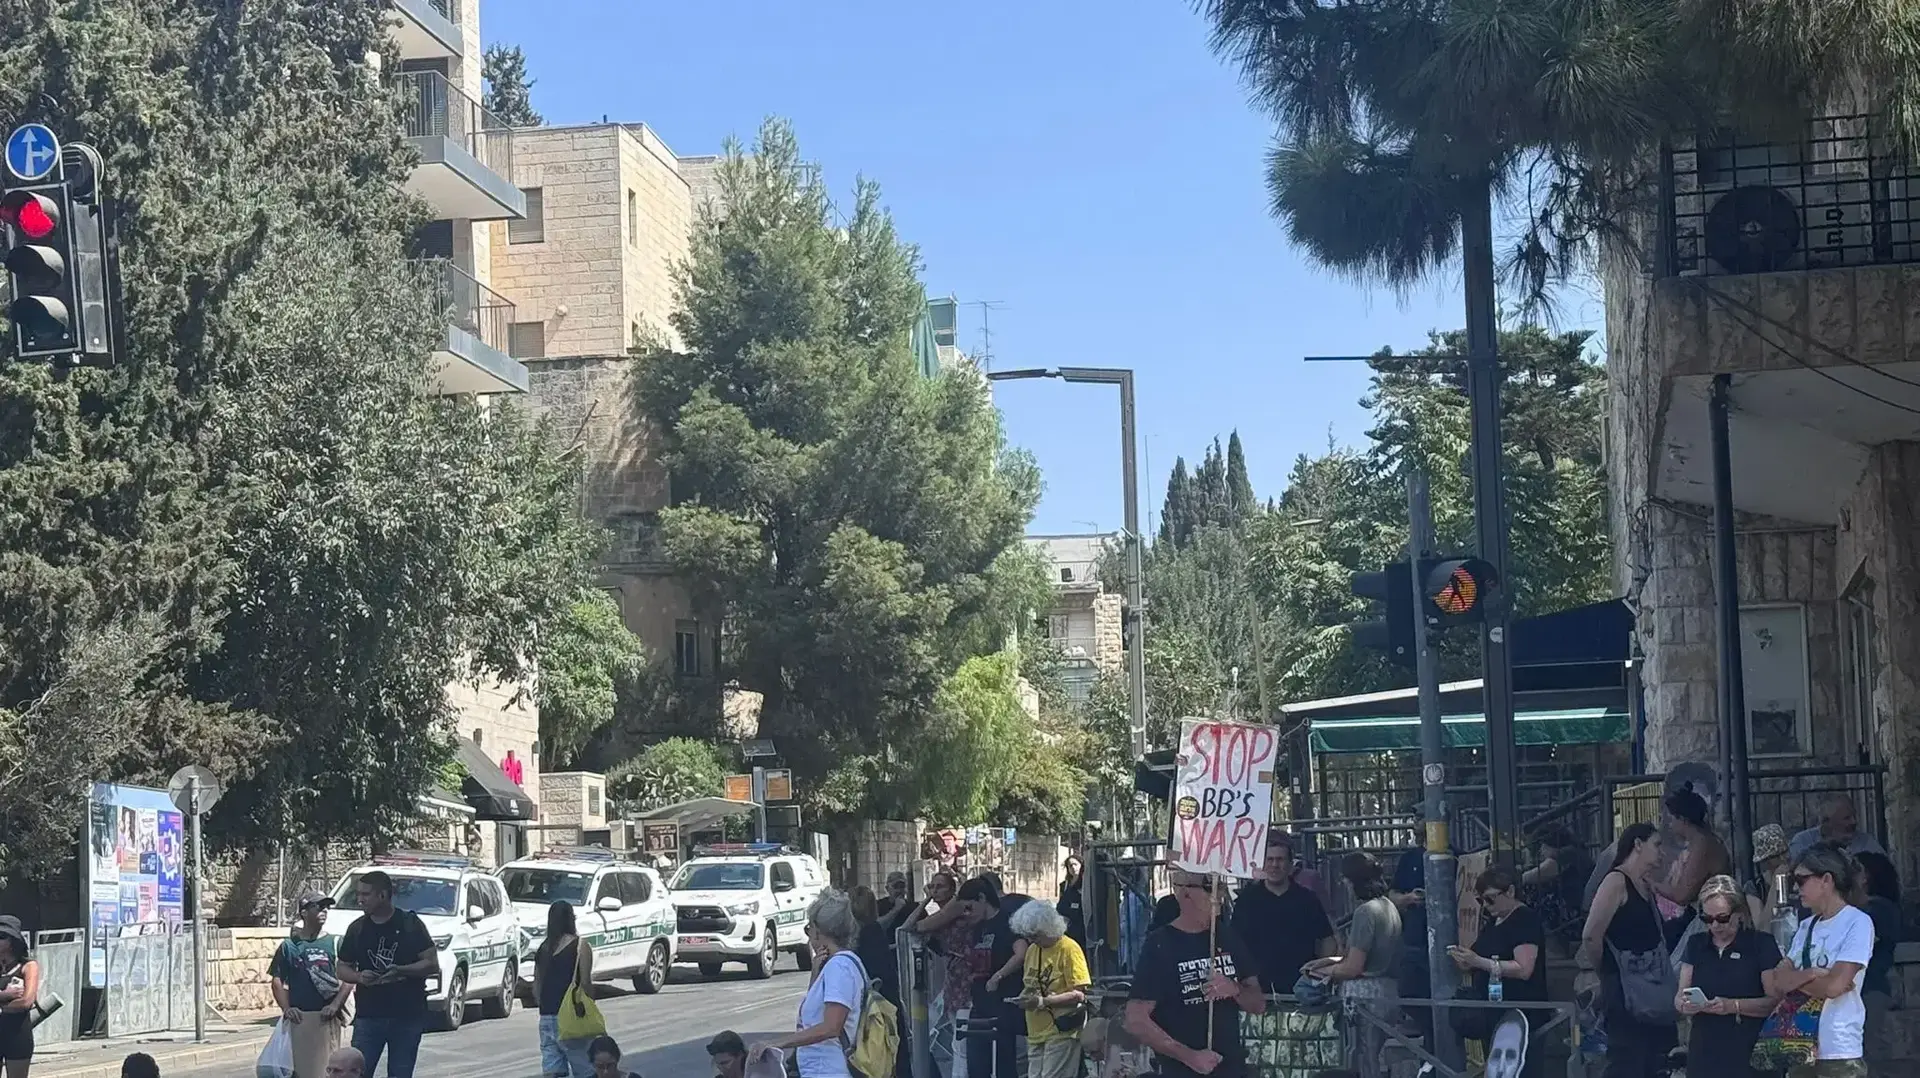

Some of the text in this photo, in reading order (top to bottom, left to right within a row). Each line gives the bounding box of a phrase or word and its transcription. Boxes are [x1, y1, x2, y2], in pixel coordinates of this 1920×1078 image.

[1187, 723, 1273, 789] STOP
[1180, 818, 1265, 873] WAR!
[1178, 956, 1221, 973] דוקרטיה
